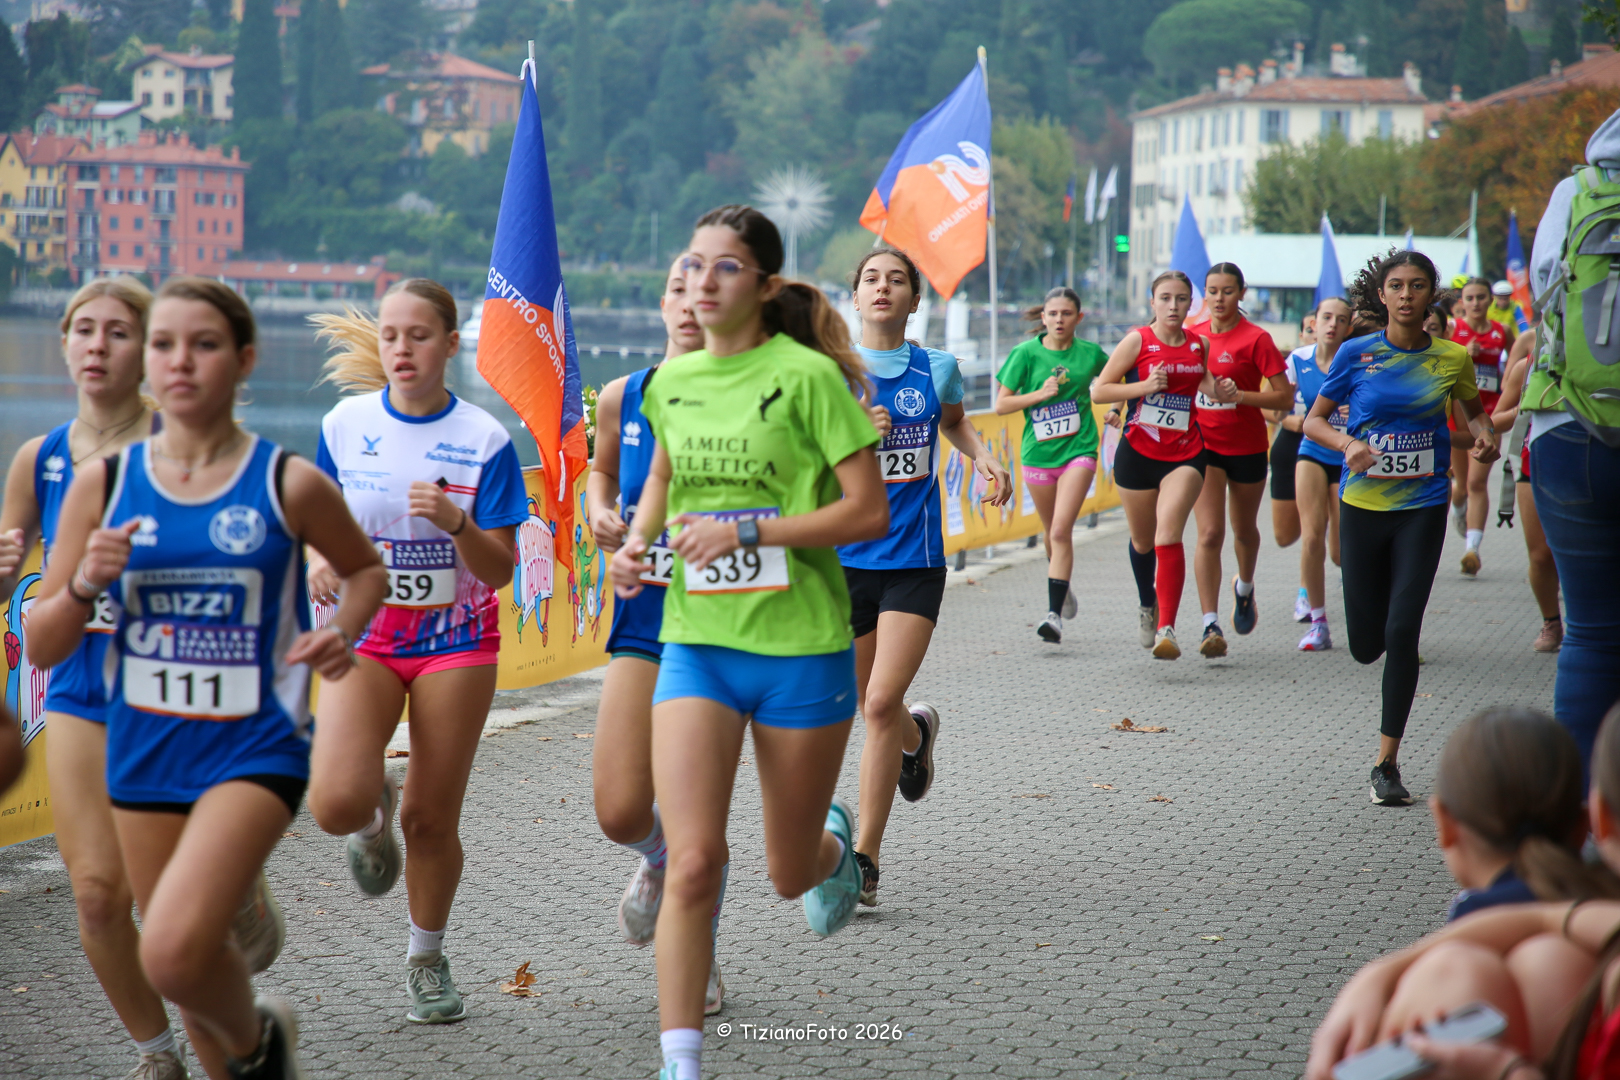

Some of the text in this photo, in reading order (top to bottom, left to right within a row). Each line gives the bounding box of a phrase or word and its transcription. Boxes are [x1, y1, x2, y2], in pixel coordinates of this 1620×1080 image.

[487, 266, 538, 324] CENTRO
[1157, 409, 1175, 426] 76
[1044, 418, 1070, 435] 377
[887, 431, 929, 441] SPORTIVO
[1397, 432, 1433, 440] CENTRO
[1397, 437, 1433, 445] SPORTIVO
[681, 436, 748, 453] AMICI
[887, 437, 929, 447] ITALIANO
[1397, 441, 1433, 449] ITALIANO
[1381, 454, 1420, 473] 354
[395, 543, 453, 551] CENTRO
[395, 550, 453, 558] SPORTIVO
[395, 557, 453, 566] ITALIANO
[148, 592, 233, 617] BIZZI
[152, 668, 222, 708] 111
